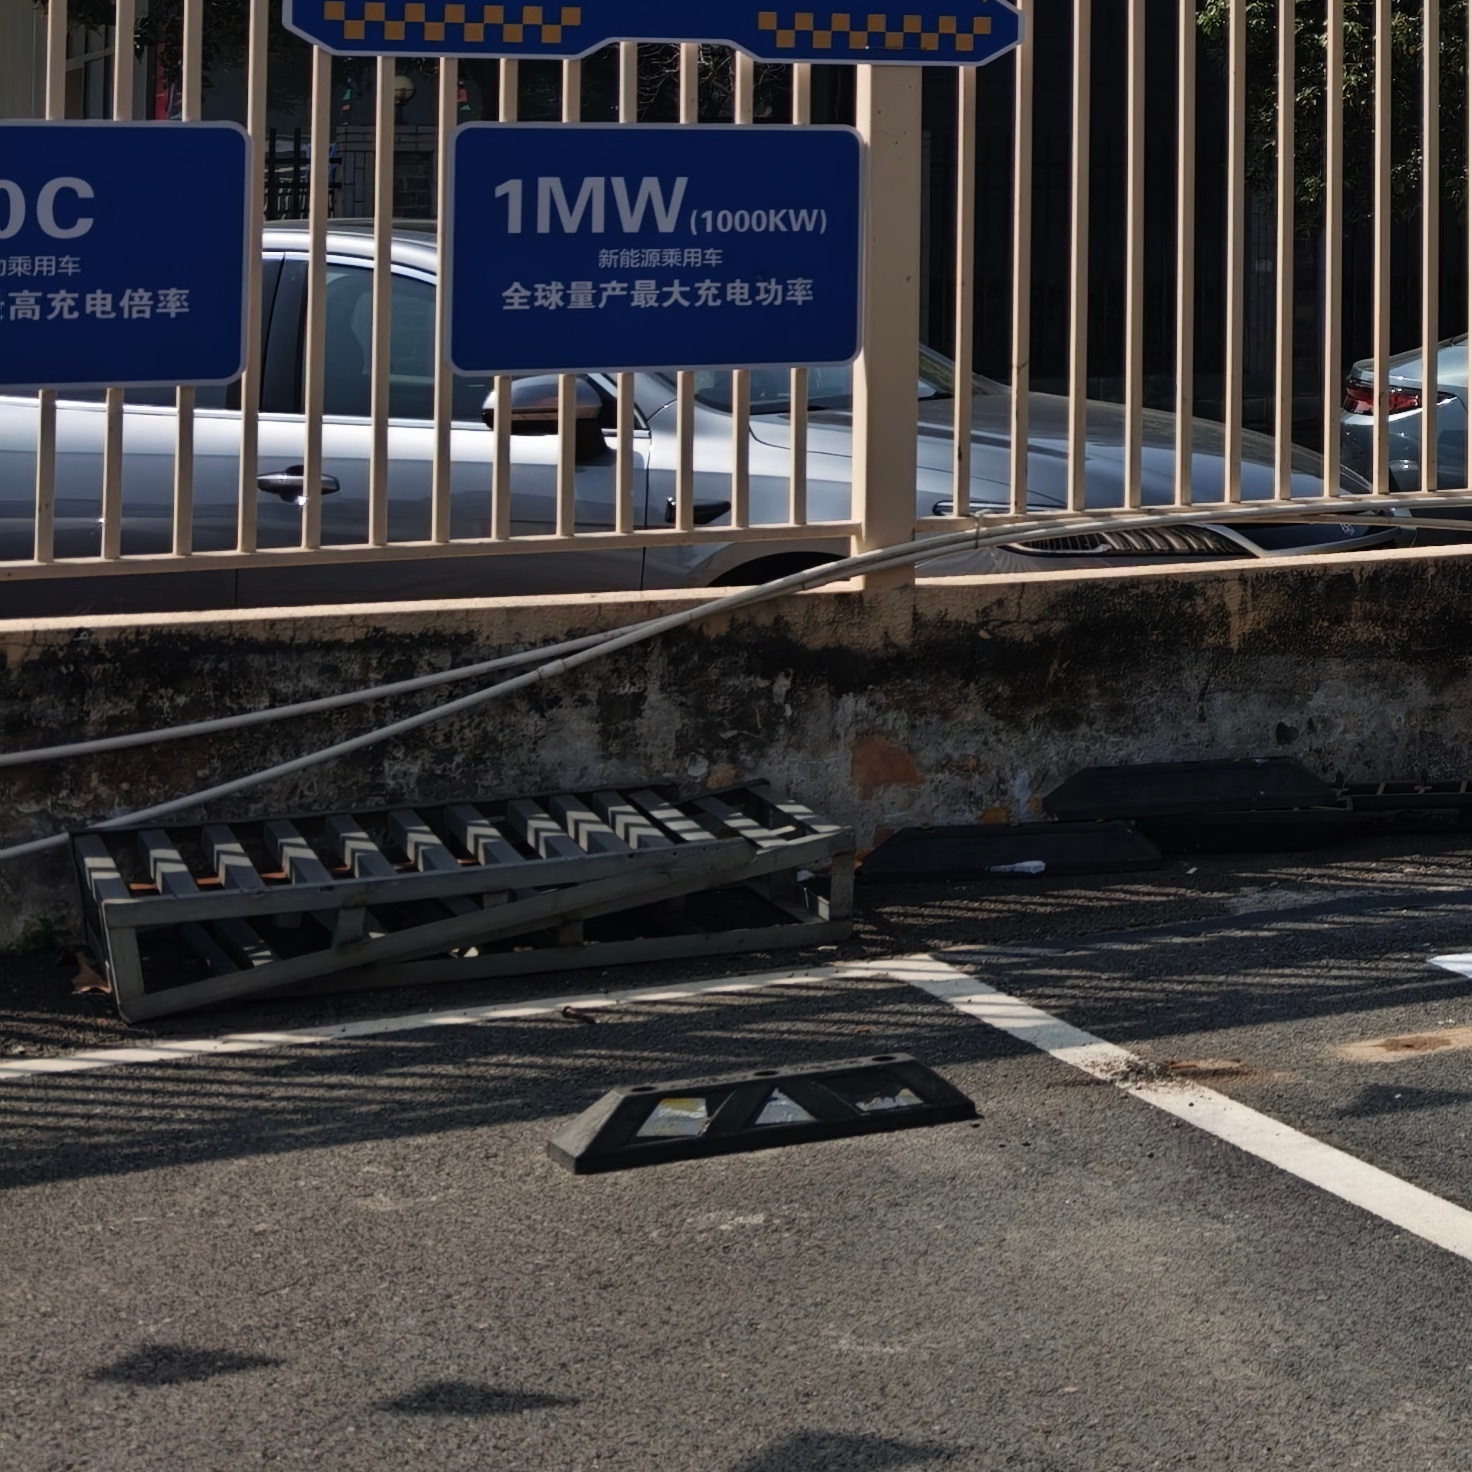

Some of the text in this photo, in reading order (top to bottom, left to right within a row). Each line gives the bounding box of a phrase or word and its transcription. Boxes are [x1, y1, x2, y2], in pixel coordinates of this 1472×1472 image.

[598, 247, 724, 269] 新能源乘用车
[0, 287, 190, 321] 高充电倍率
[501, 277, 814, 310] 全球量产最大充电功率
